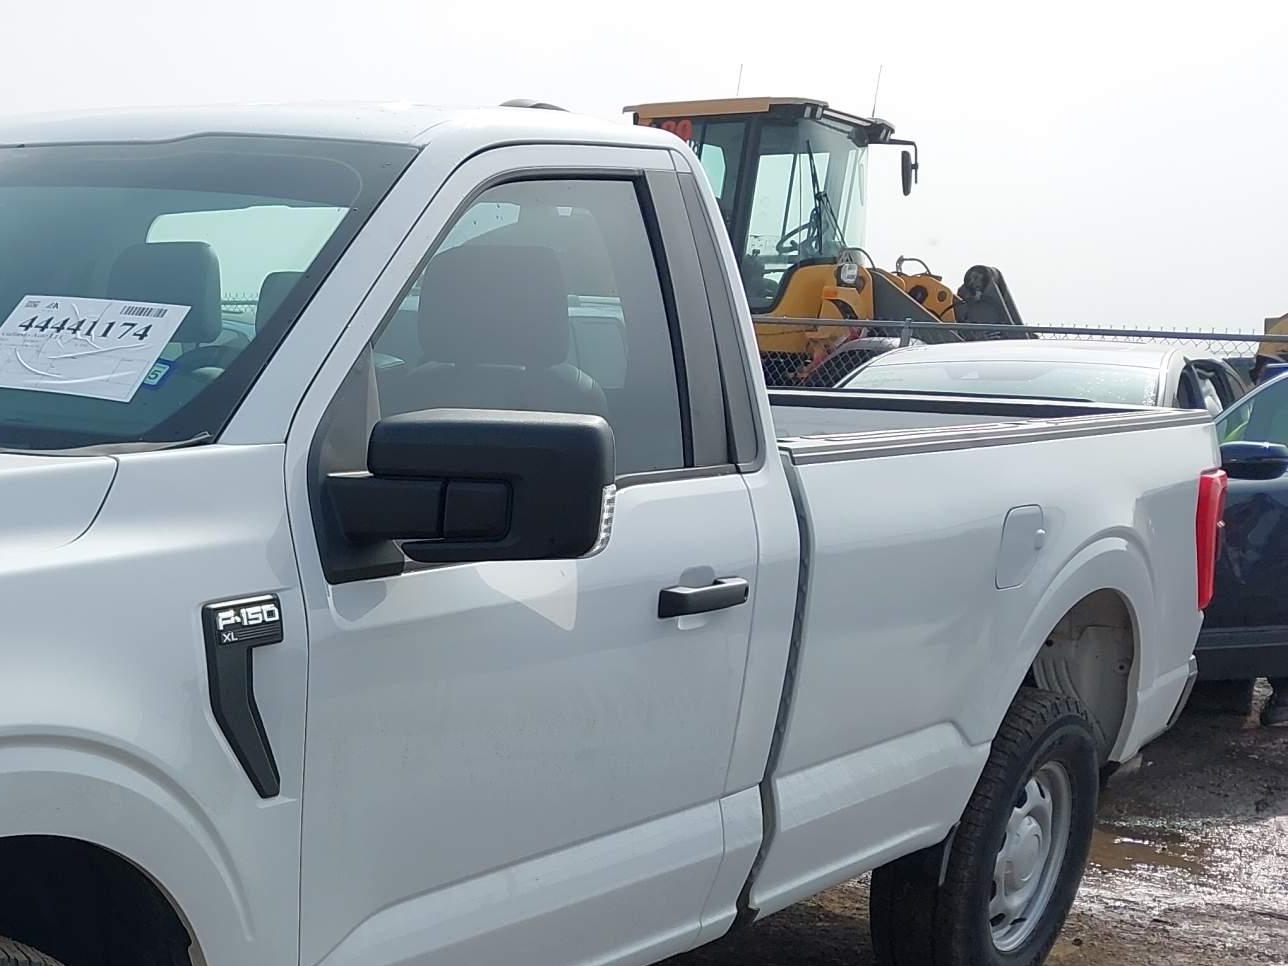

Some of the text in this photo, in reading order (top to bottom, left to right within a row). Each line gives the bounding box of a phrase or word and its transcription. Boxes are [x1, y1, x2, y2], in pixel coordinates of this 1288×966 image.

[18, 315, 153, 341] 44441174
[216, 603, 279, 630] F-150
[222, 631, 238, 642] XL
